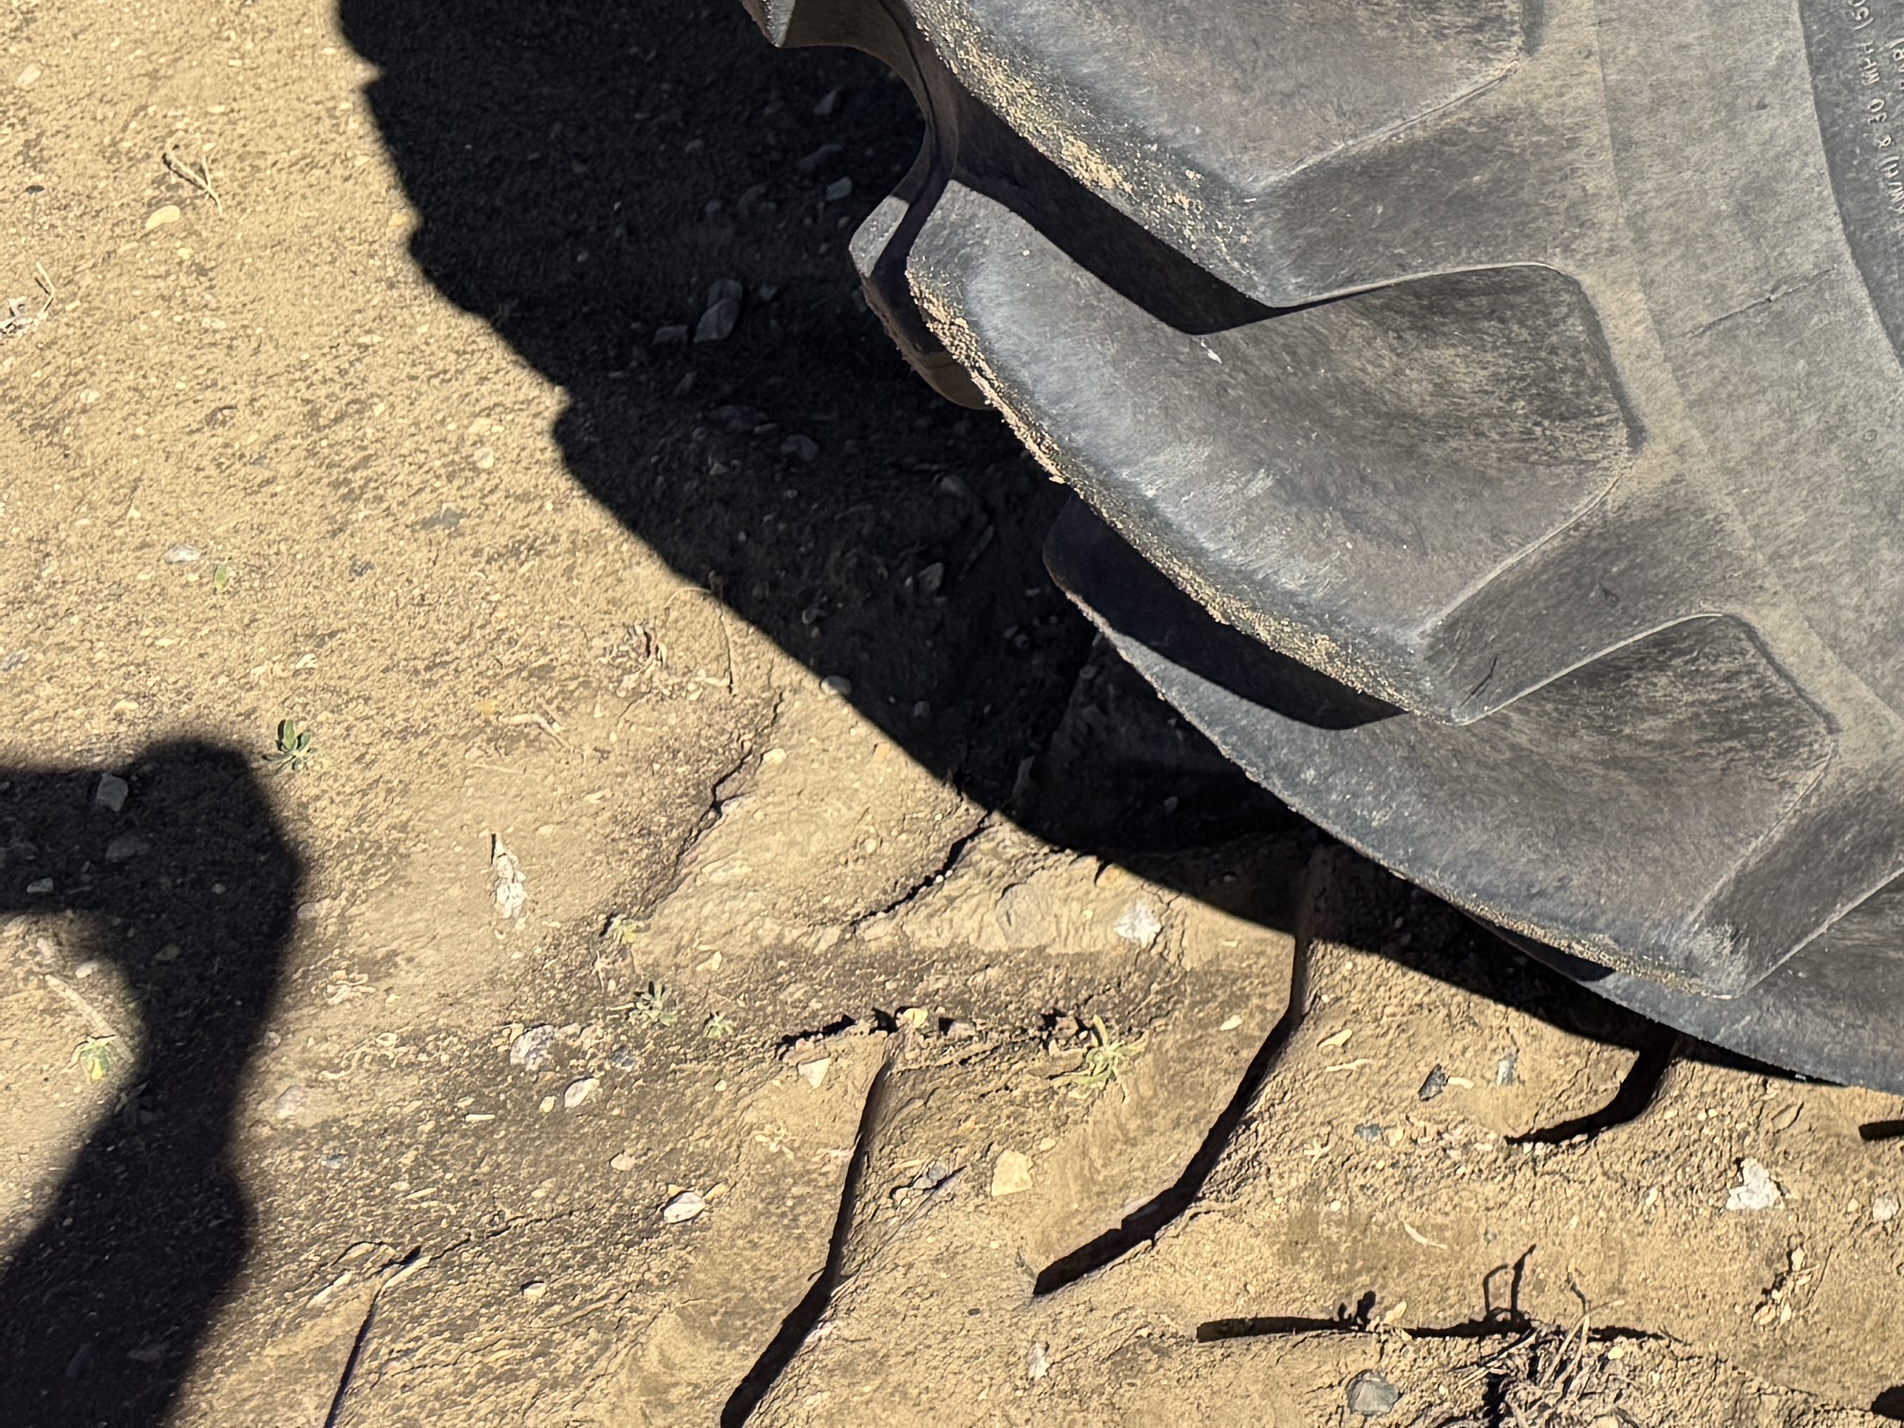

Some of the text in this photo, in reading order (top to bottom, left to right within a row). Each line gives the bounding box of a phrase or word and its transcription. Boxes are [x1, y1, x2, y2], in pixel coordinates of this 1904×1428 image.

[1853, 39, 1882, 85] MPH
[1864, 96, 1888, 124] 30
[1871, 133, 1893, 149] &
